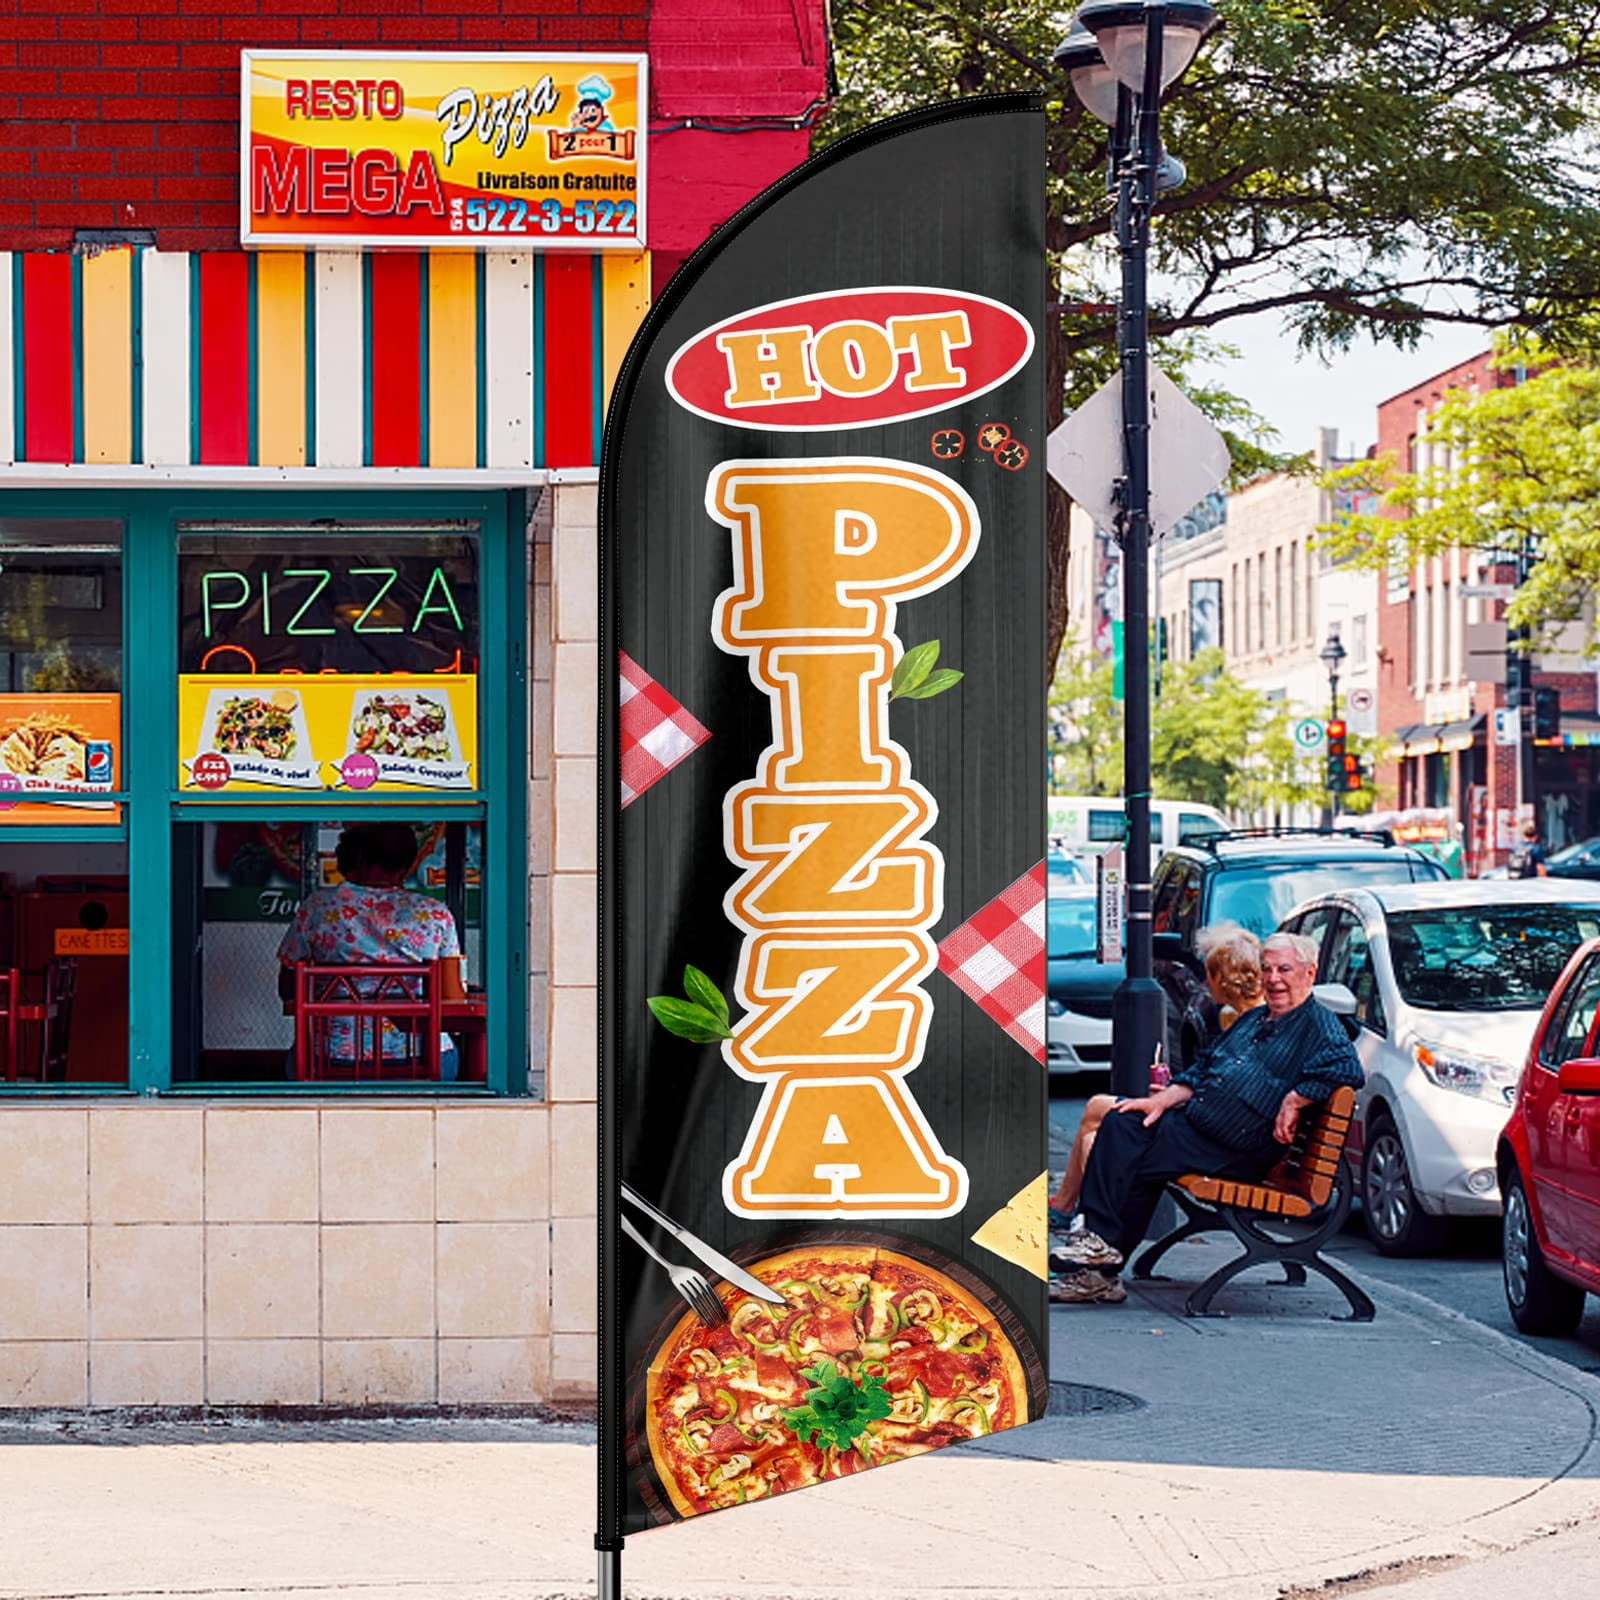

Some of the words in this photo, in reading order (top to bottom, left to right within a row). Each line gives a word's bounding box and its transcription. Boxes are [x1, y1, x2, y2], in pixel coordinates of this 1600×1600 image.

[286, 79, 402, 118] RESTO
[436, 75, 561, 165] Pizza
[563, 135, 576, 152] 2
[579, 138, 605, 148] pour
[606, 135, 616, 151] 1
[251, 146, 444, 216] MEGA
[477, 171, 559, 191] Livraison
[563, 172, 637, 191] Gratuite
[466, 198, 636, 233] 522-3-522
[717, 310, 971, 408] HOT
[201, 568, 464, 637] PIZZA
[705, 456, 981, 1221] PIZZA
[59, 933, 128, 949] CANETTES
